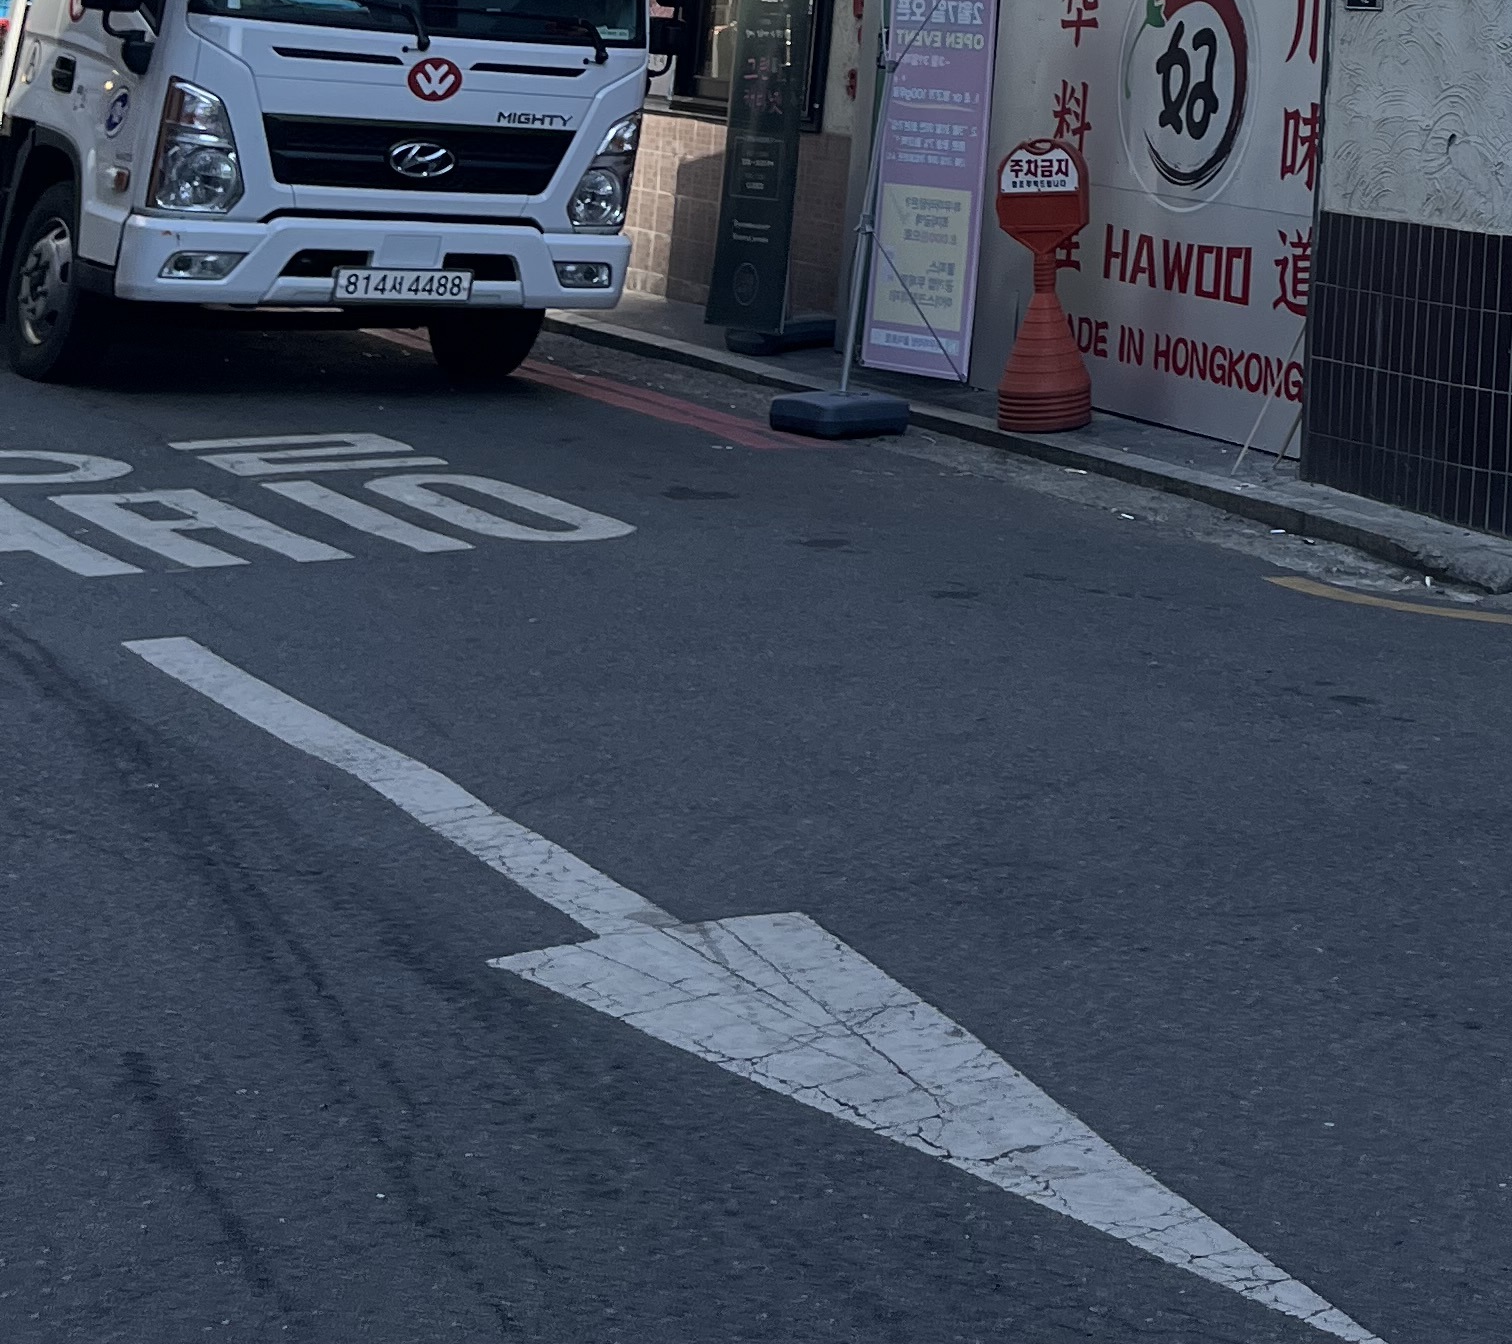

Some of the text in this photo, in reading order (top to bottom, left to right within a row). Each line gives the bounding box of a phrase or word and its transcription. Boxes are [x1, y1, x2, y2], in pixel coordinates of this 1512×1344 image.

[496, 111, 573, 127] MIGHTY
[1010, 159, 1069, 178] 주차금지
[1103, 223, 1253, 306] HAWOO
[1118, 324, 1145, 366] IN
[1153, 333, 1305, 404] HONGKONG
